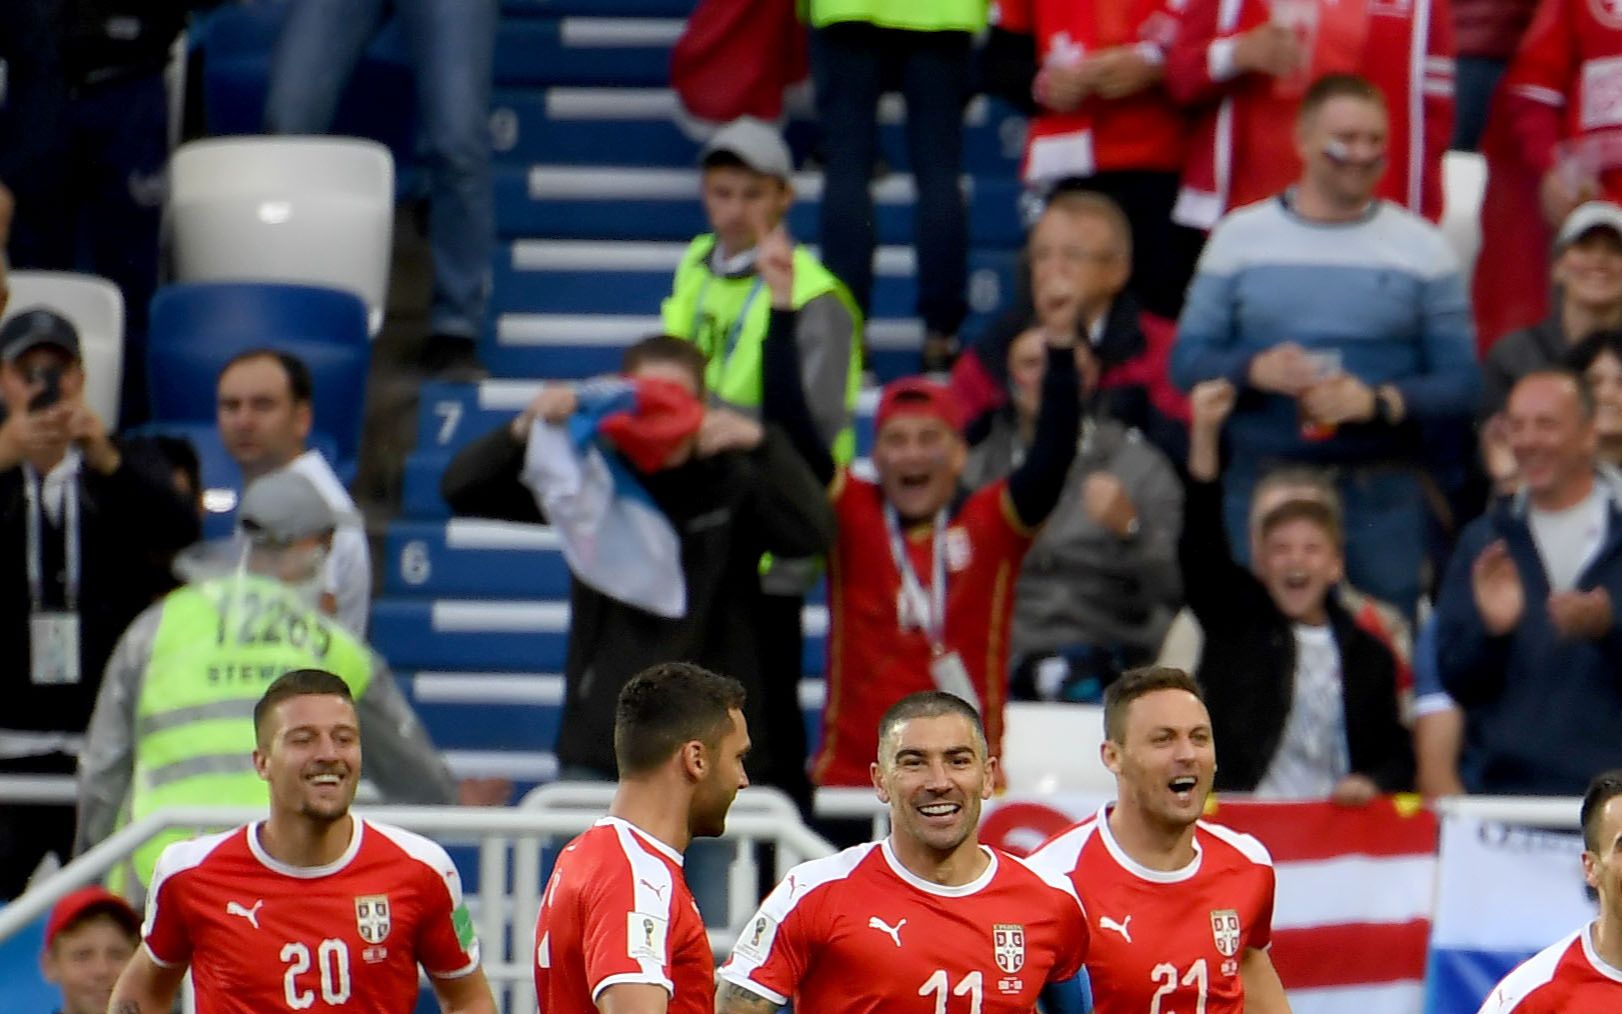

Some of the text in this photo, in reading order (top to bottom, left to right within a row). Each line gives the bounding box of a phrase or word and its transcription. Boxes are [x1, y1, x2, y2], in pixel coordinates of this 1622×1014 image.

[434, 401, 463, 445] 7
[401, 540, 432, 585] 6
[279, 937, 351, 1010] 20
